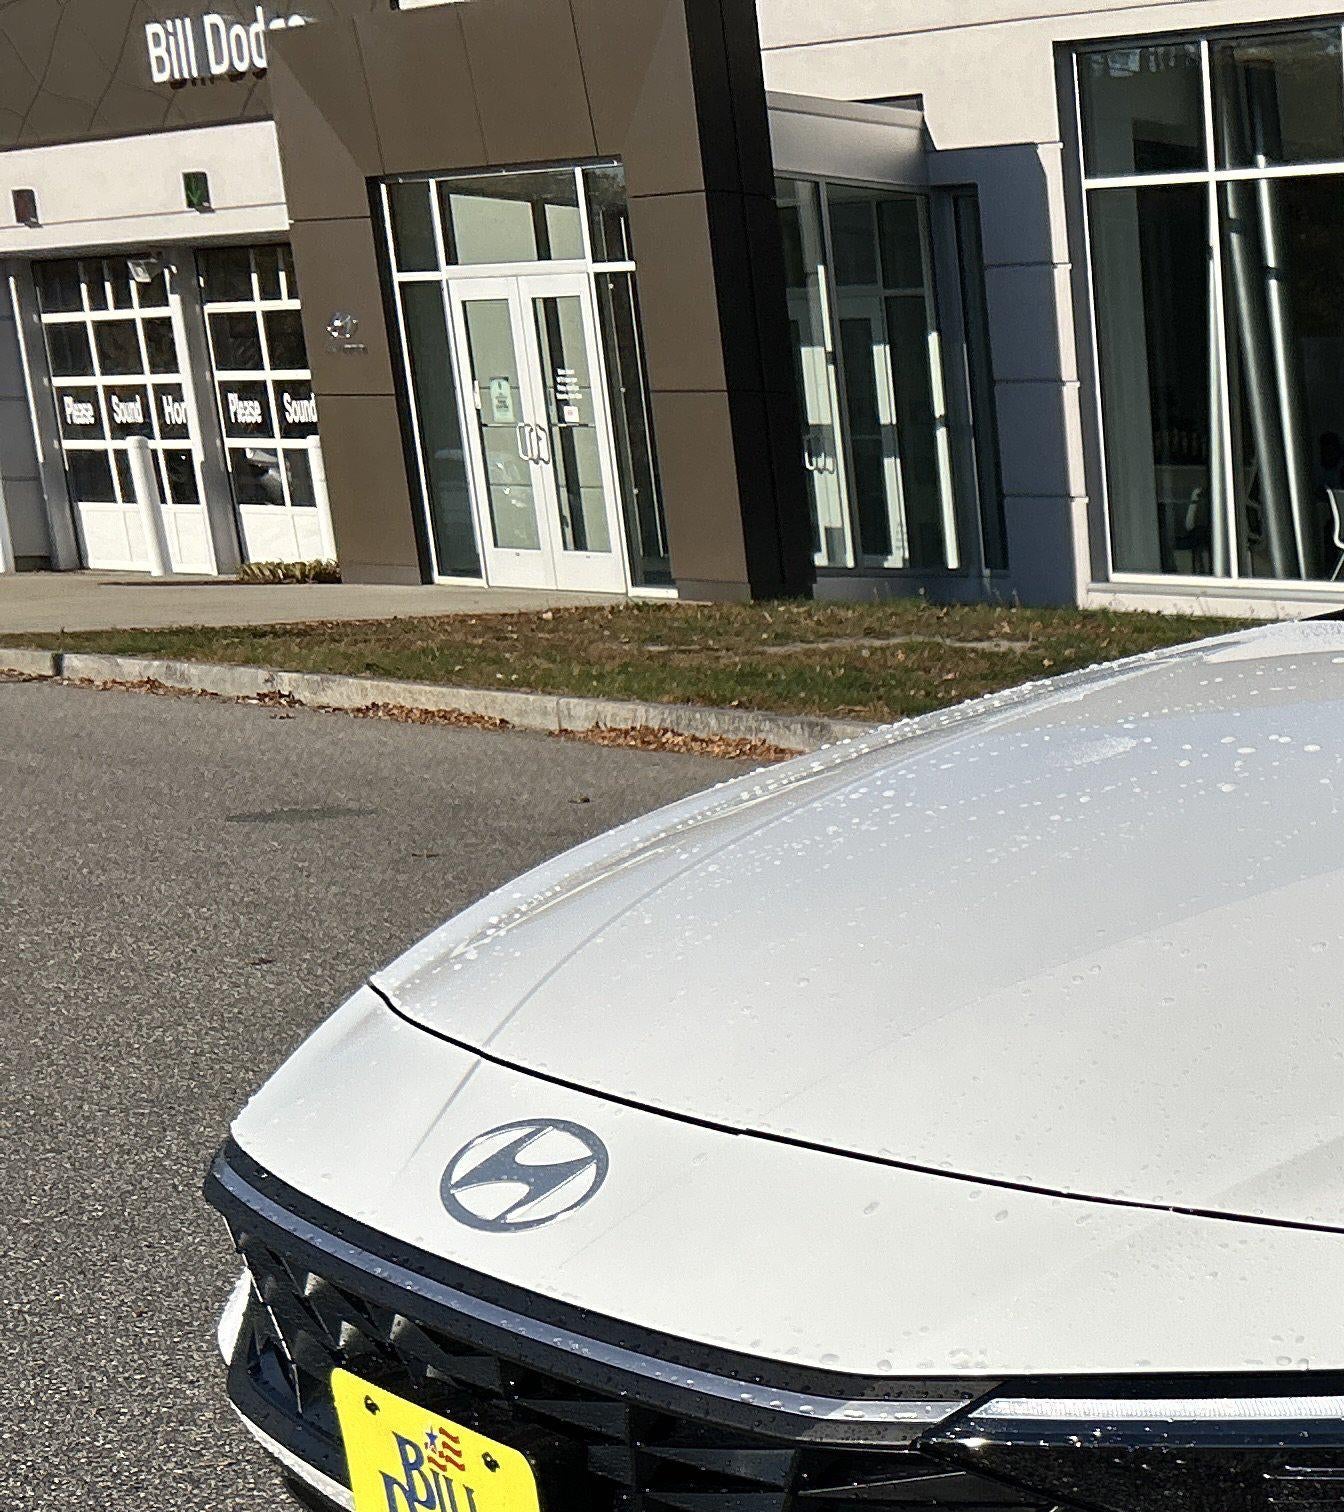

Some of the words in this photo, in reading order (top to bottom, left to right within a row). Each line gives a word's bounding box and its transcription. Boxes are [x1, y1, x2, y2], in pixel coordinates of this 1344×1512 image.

[145, 17, 198, 83] Bill
[203, 5, 306, 75] Dod
[63, 394, 95, 425] Please
[111, 394, 144, 424] Sound
[161, 395, 187, 425] Hor
[227, 392, 263, 424] Please
[283, 392, 318, 423] Sound
